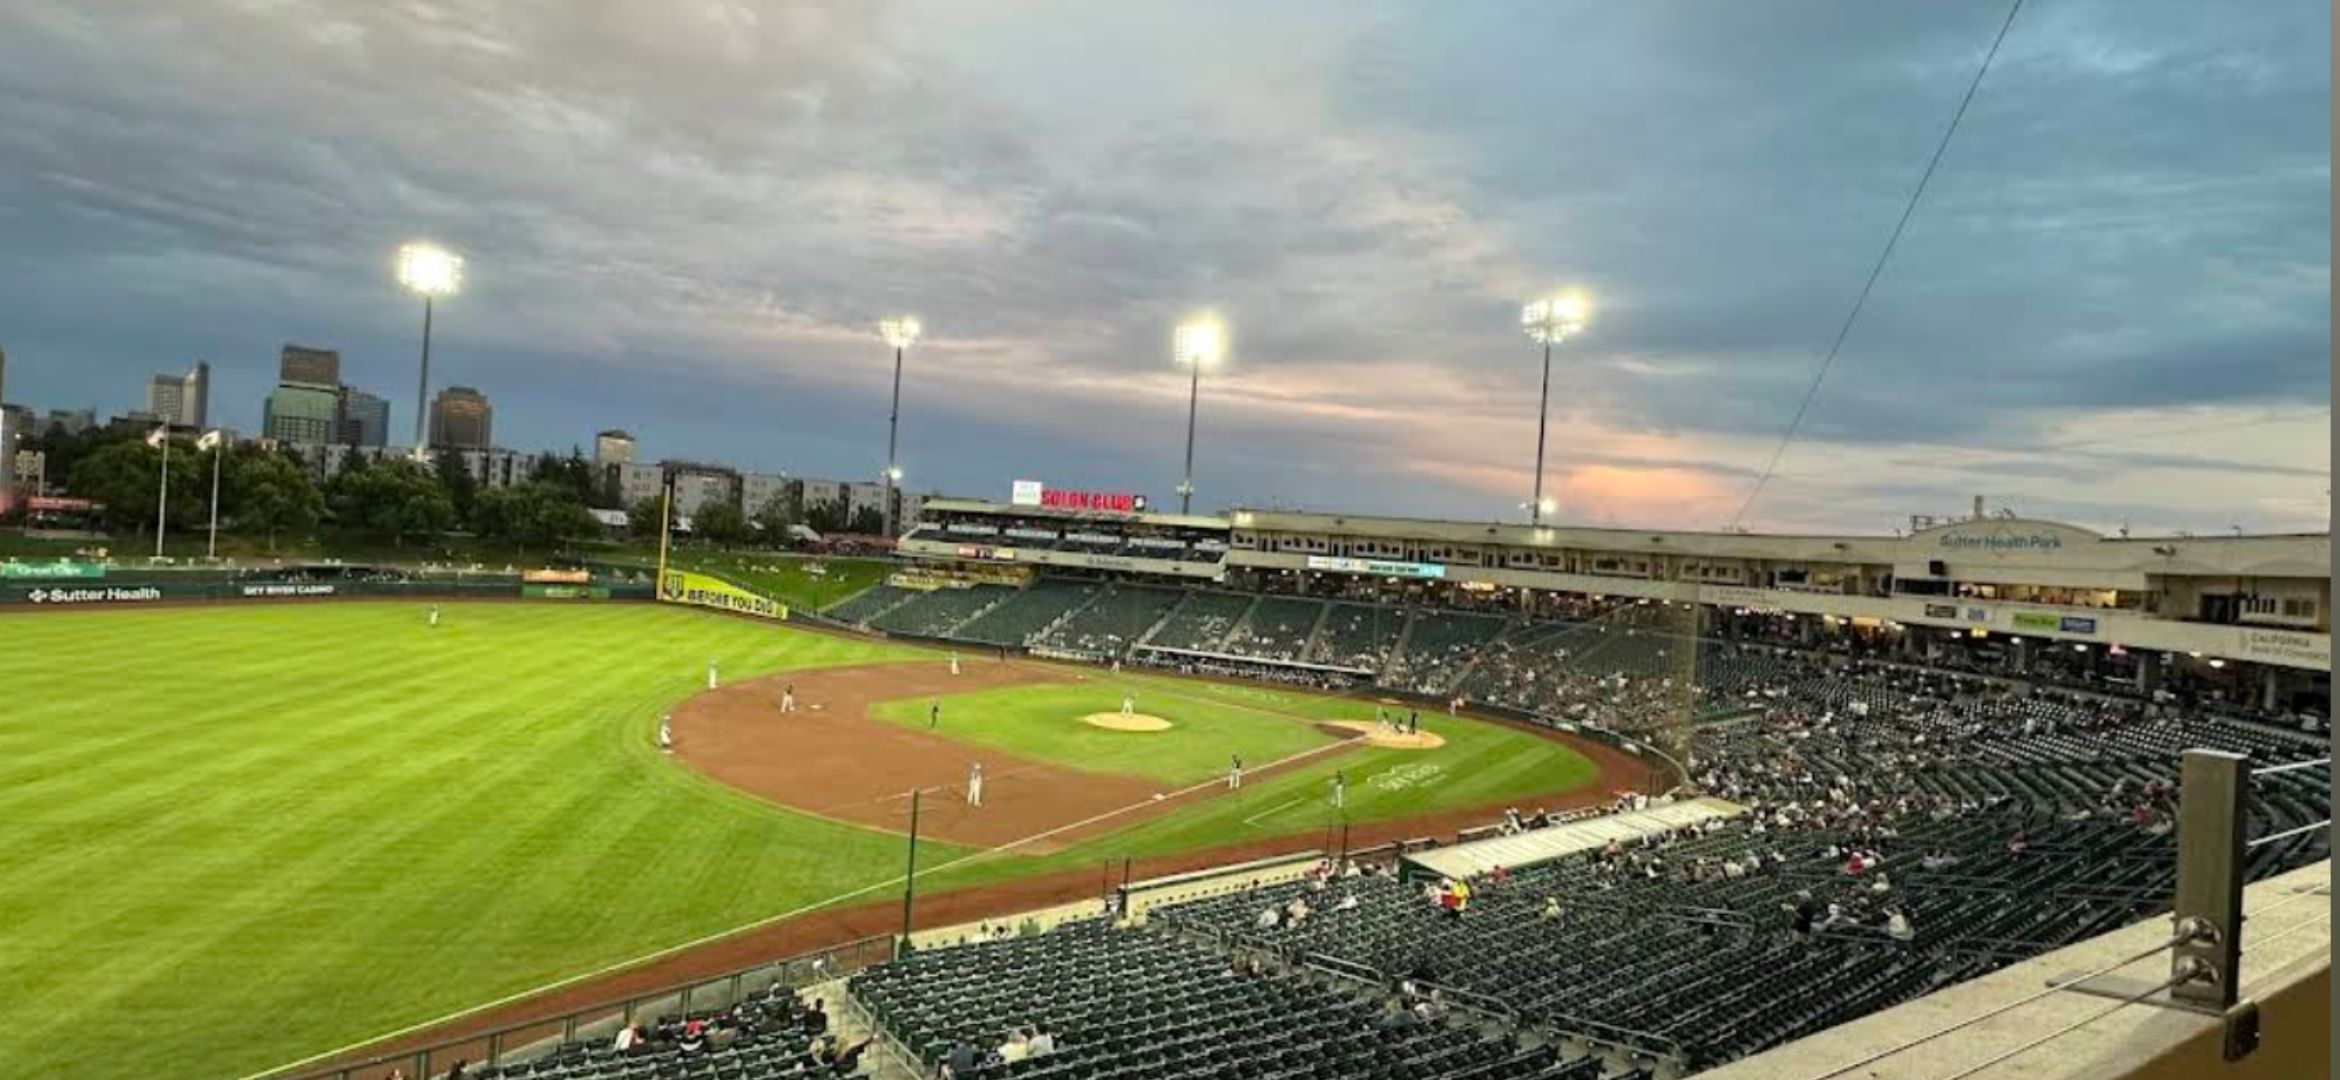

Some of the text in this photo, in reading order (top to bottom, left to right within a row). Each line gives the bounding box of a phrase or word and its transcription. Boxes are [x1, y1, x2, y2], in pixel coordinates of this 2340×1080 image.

[1092, 492, 1132, 511] CLUB
[1939, 535, 2062, 548] Sutter Health Park
[50, 586, 162, 604] Sutter Health
[243, 585, 264, 596] SKY
[297, 583, 335, 594] CASINO
[687, 588, 730, 607] BEFORE
[732, 595, 752, 610] YOU
[2251, 632, 2310, 648] CALIFORNIA
